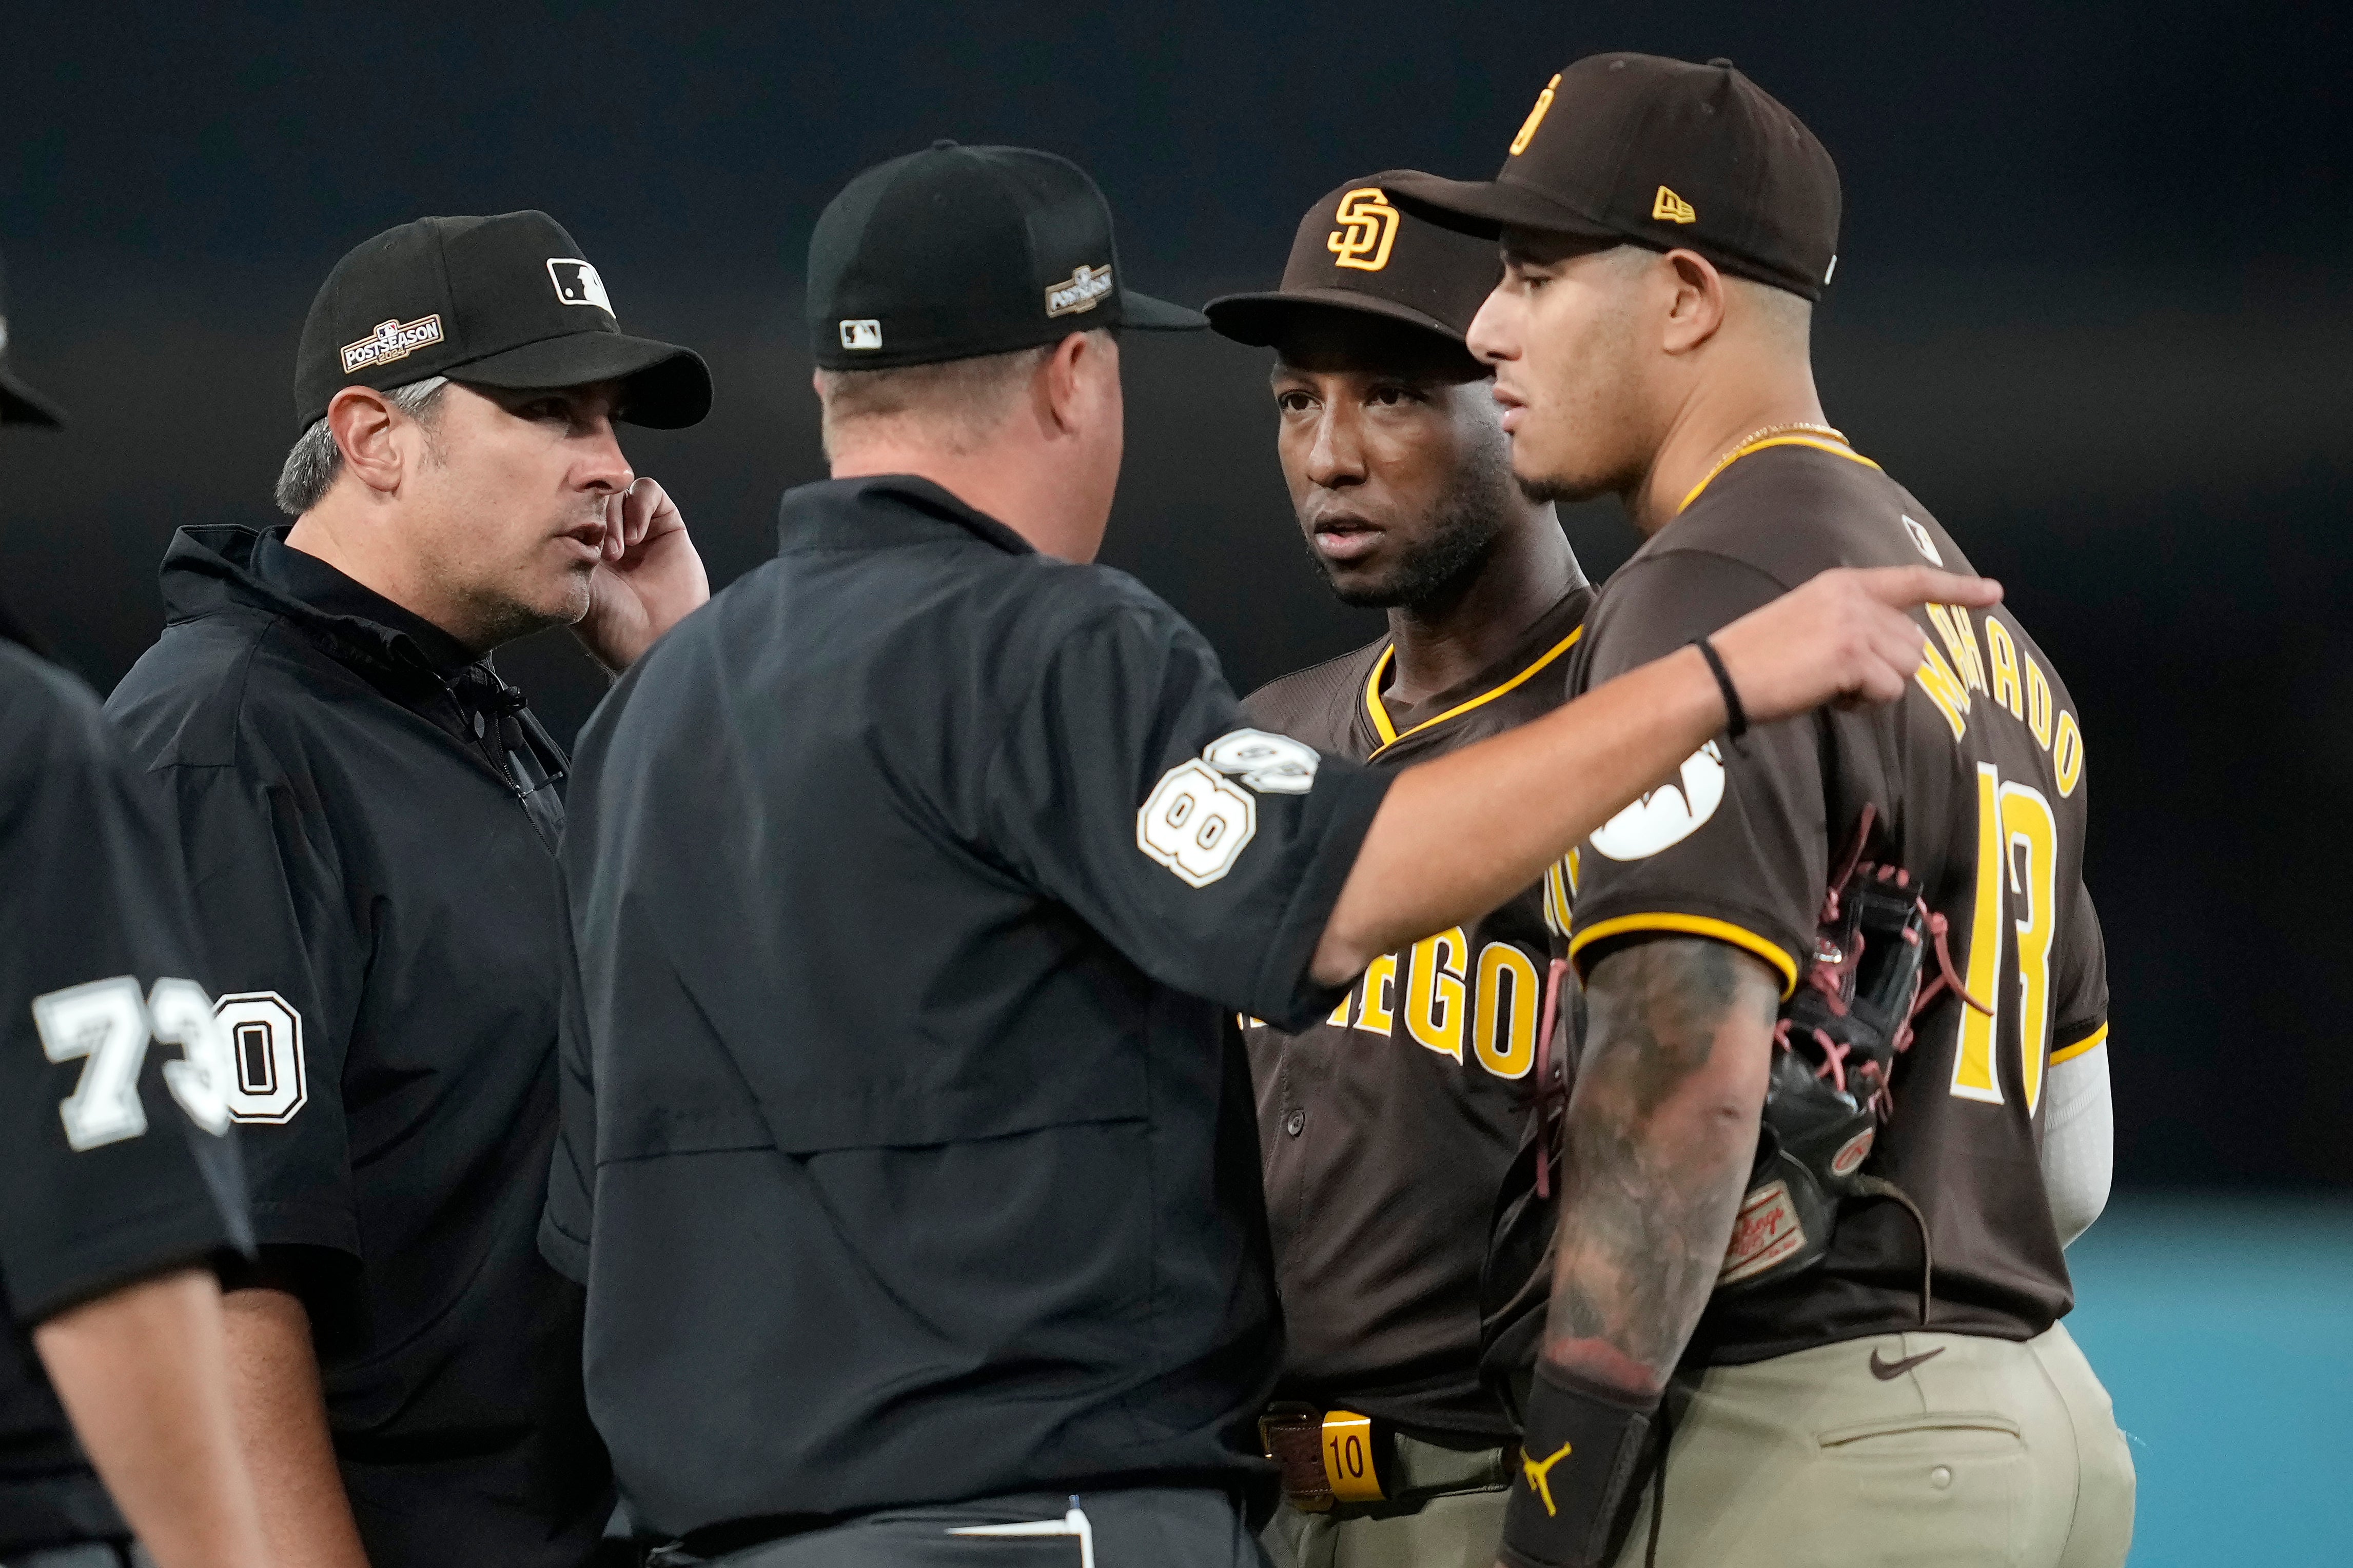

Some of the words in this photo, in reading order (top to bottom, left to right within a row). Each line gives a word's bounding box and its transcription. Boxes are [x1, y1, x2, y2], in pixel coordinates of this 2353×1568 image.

[1327, 187, 1400, 272] SD
[345, 322, 439, 366] POSTSEASON
[378, 347, 406, 362] 2024
[1914, 602, 2084, 797] MAHADO
[1136, 727, 1322, 888] 89
[1326, 925, 1540, 1079] EGO
[1949, 760, 2057, 1118] 13
[31, 974, 230, 1152] 73
[1330, 1434, 1363, 1479] 10
